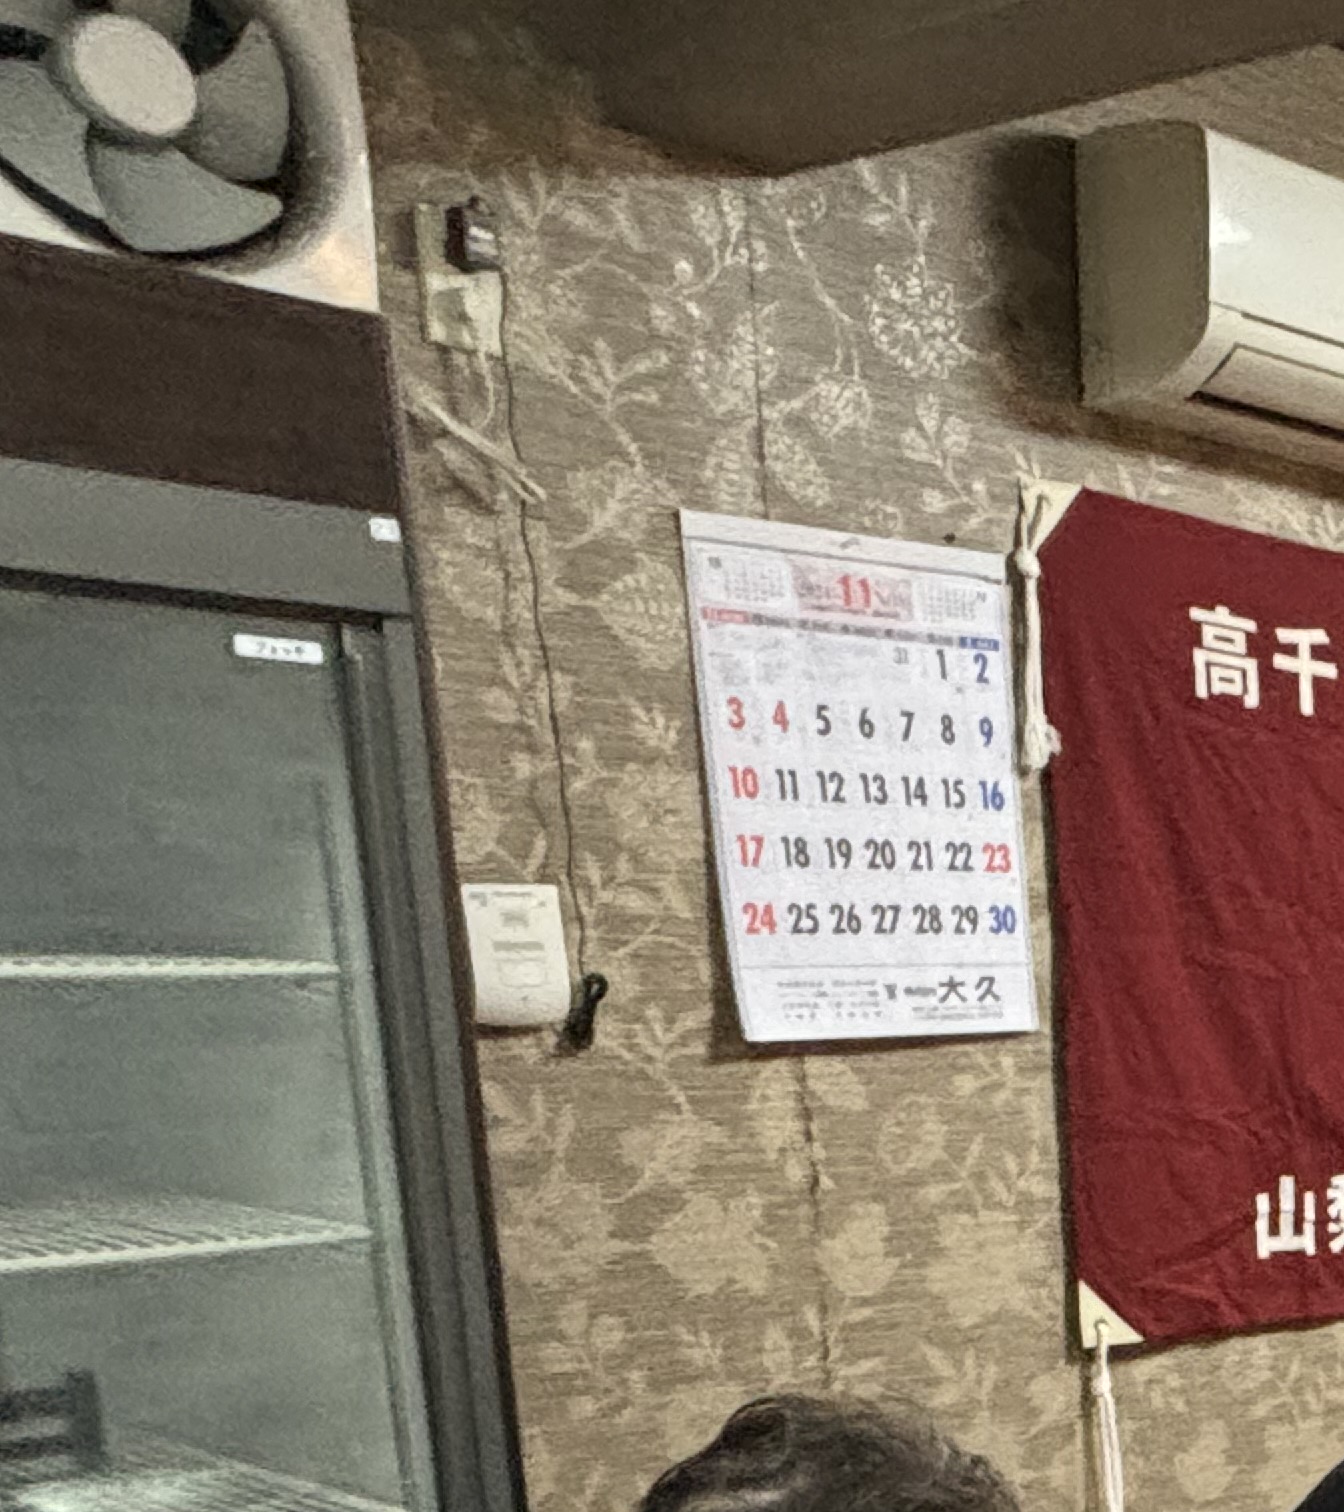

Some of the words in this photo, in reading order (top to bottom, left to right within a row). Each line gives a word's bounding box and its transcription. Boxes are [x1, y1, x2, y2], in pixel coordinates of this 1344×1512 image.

[837, 574, 872, 608] 11
[936, 648, 948, 681] 1
[973, 652, 990, 685] 2
[726, 696, 746, 731] 3
[772, 700, 790, 734] 4
[816, 704, 832, 737] 5
[858, 707, 875, 740] 6
[900, 710, 915, 742] 7
[940, 714, 956, 746] 8
[978, 716, 994, 747] 9
[727, 765, 760, 800] 10
[774, 768, 800, 802] 11
[816, 770, 846, 804] 12
[858, 772, 889, 806] 13
[900, 775, 928, 807] 14
[940, 778, 966, 810] 15
[978, 780, 1006, 812] 16
[736, 834, 764, 868] 17
[780, 836, 811, 869] 18
[824, 837, 852, 870] 19
[863, 838, 896, 871] 20
[907, 840, 934, 872] 21
[944, 840, 974, 872] 22
[982, 842, 1012, 874] 23
[742, 902, 778, 935] 24
[787, 902, 820, 936] 25
[828, 903, 862, 936] 26
[870, 903, 902, 935] 27
[912, 903, 944, 936] 28
[950, 904, 979, 935] 29
[988, 904, 1017, 935] 30
